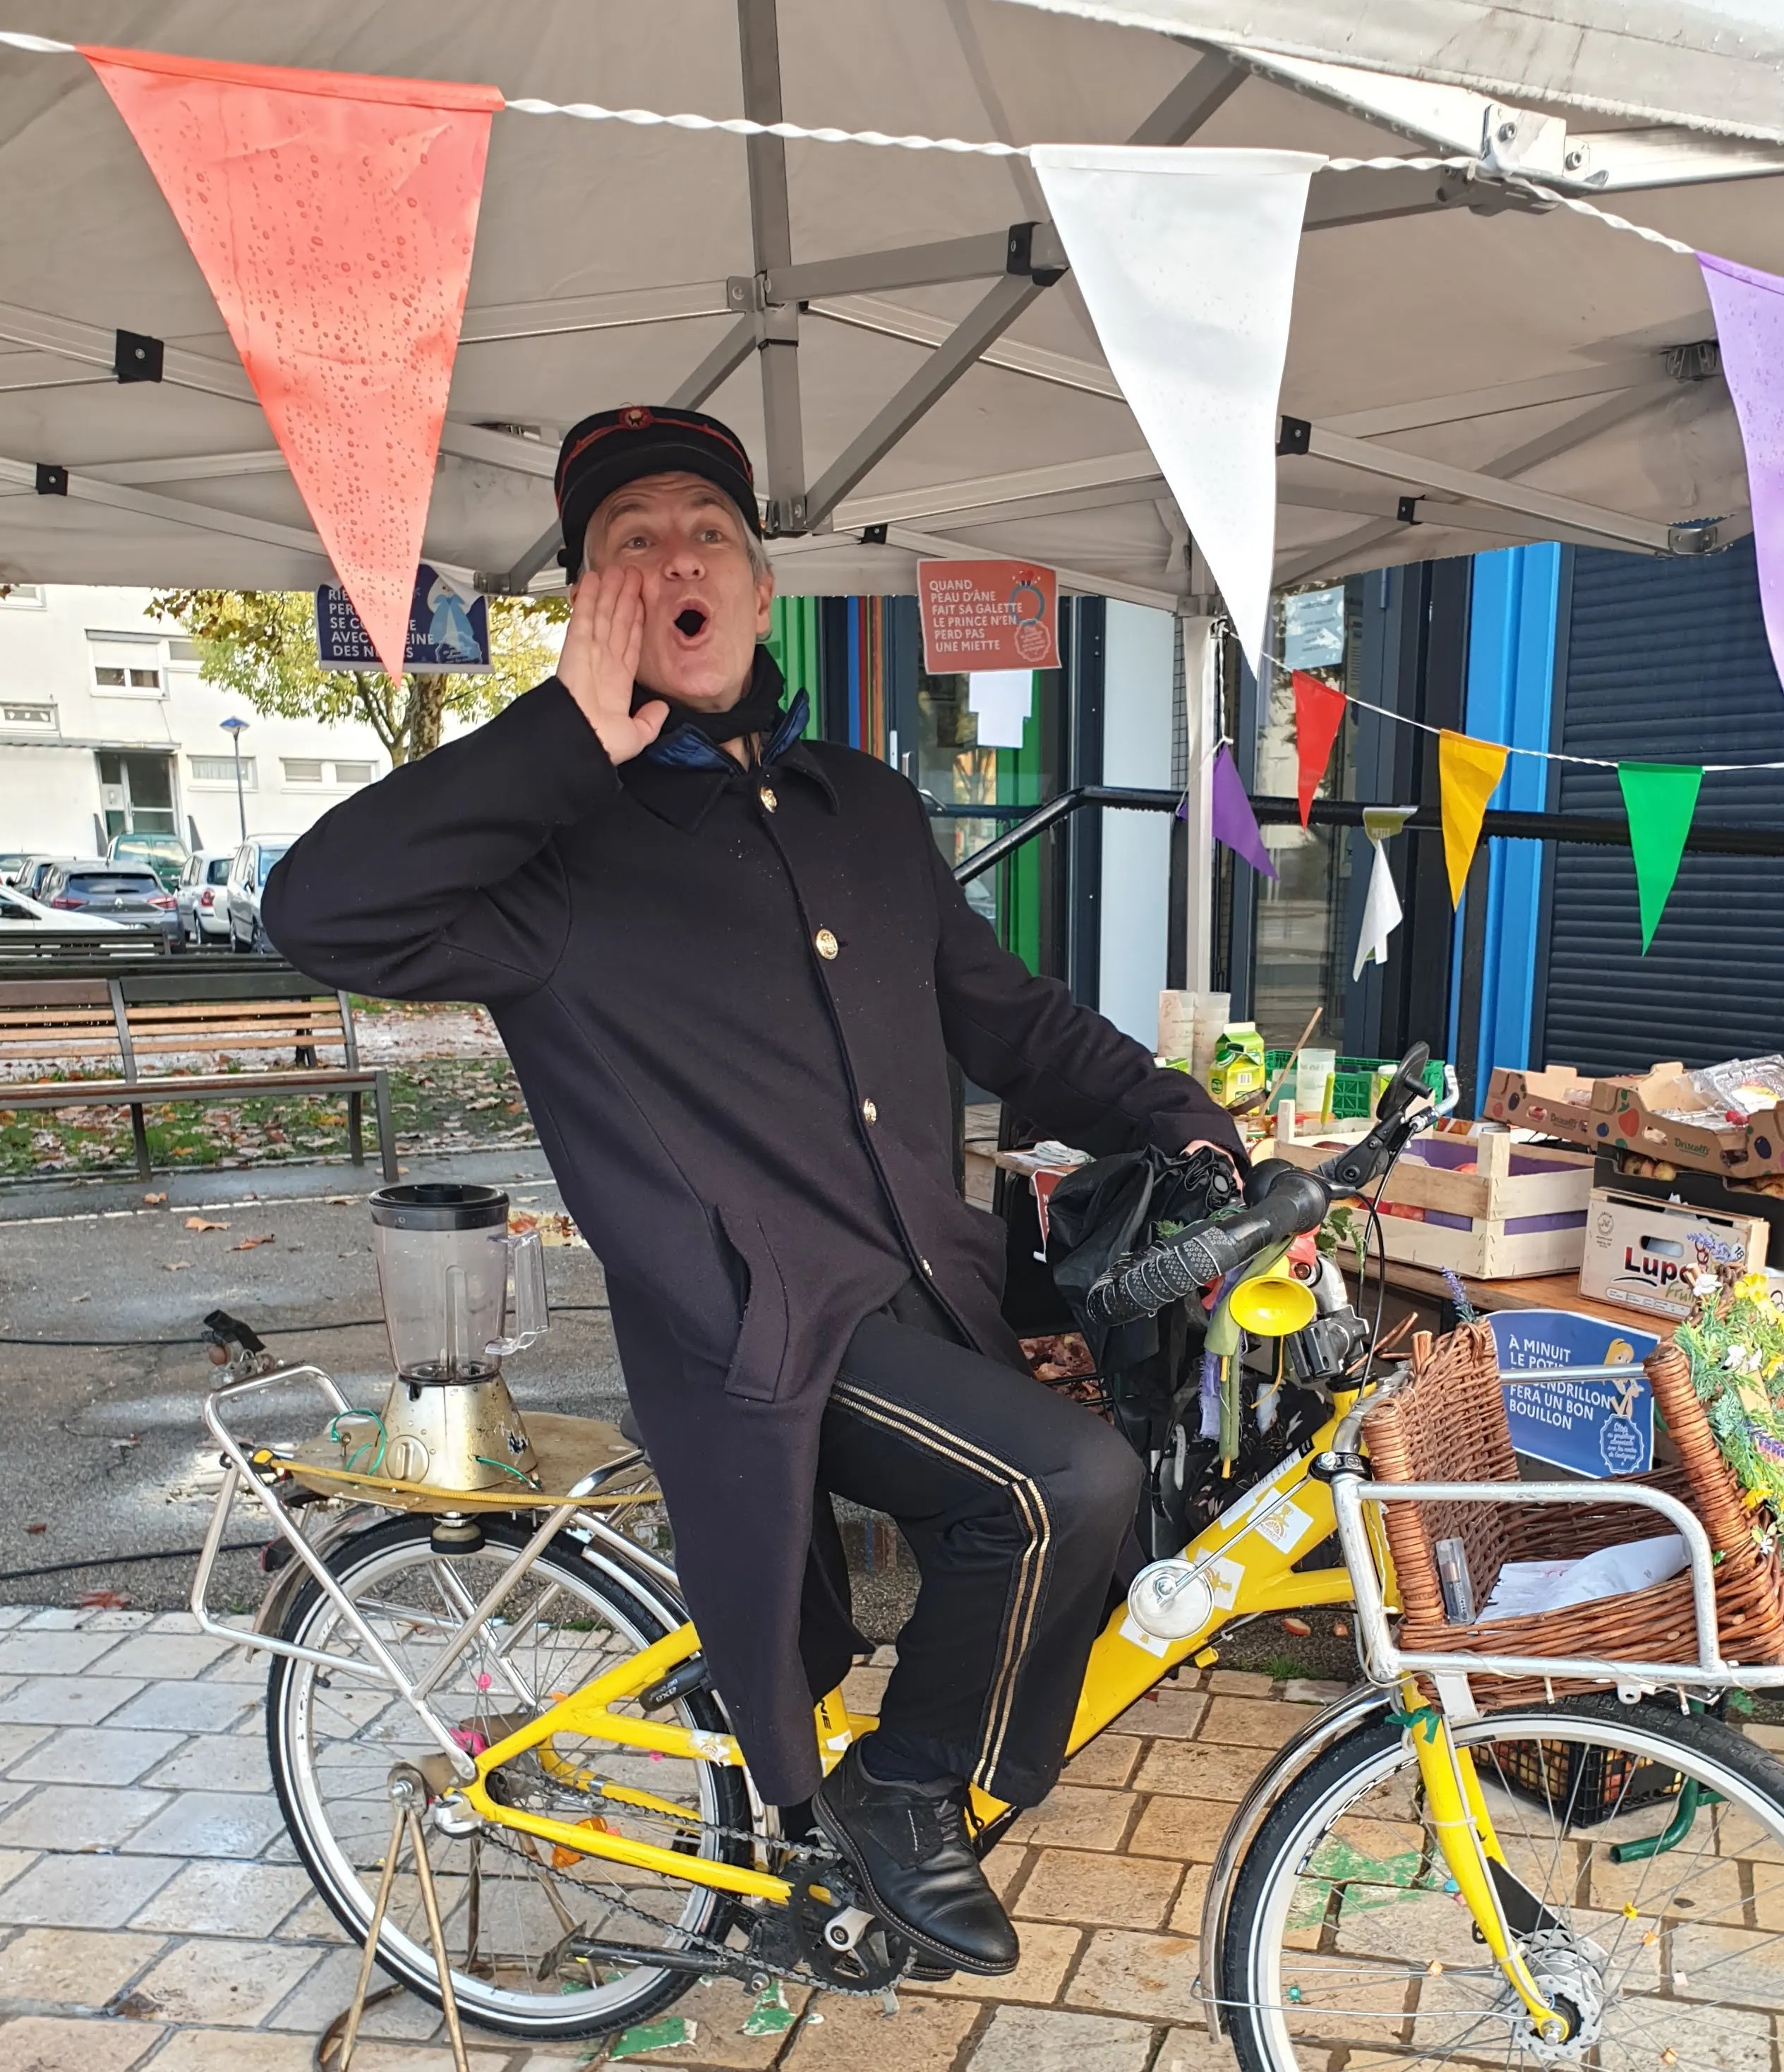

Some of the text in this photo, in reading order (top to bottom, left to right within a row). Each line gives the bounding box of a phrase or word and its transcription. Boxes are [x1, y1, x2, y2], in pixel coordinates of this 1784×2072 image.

[929, 579, 972, 592] QUAND
[329, 589, 350, 601] RIE
[931, 590, 996, 603] PEAU D'ÂNE
[329, 603, 354, 615] PER
[932, 603, 1023, 615] FAIT SA GALETTE
[330, 617, 346, 629] SE
[933, 615, 1017, 628] LE PRINCE N'EN
[331, 632, 434, 645] AVEC EINE
[934, 628, 985, 640] PERD PAS
[333, 645, 359, 657] DES
[936, 639, 1001, 652] UNE MIETTE
[1734, 1246, 1744, 1260] 18
[1509, 1334, 1571, 1363] À MINUIT
[1510, 1351, 1524, 1366] LE
[1510, 1385, 1593, 1421] FERA UN BON
[1509, 1399, 1572, 1430] BOUILLON
